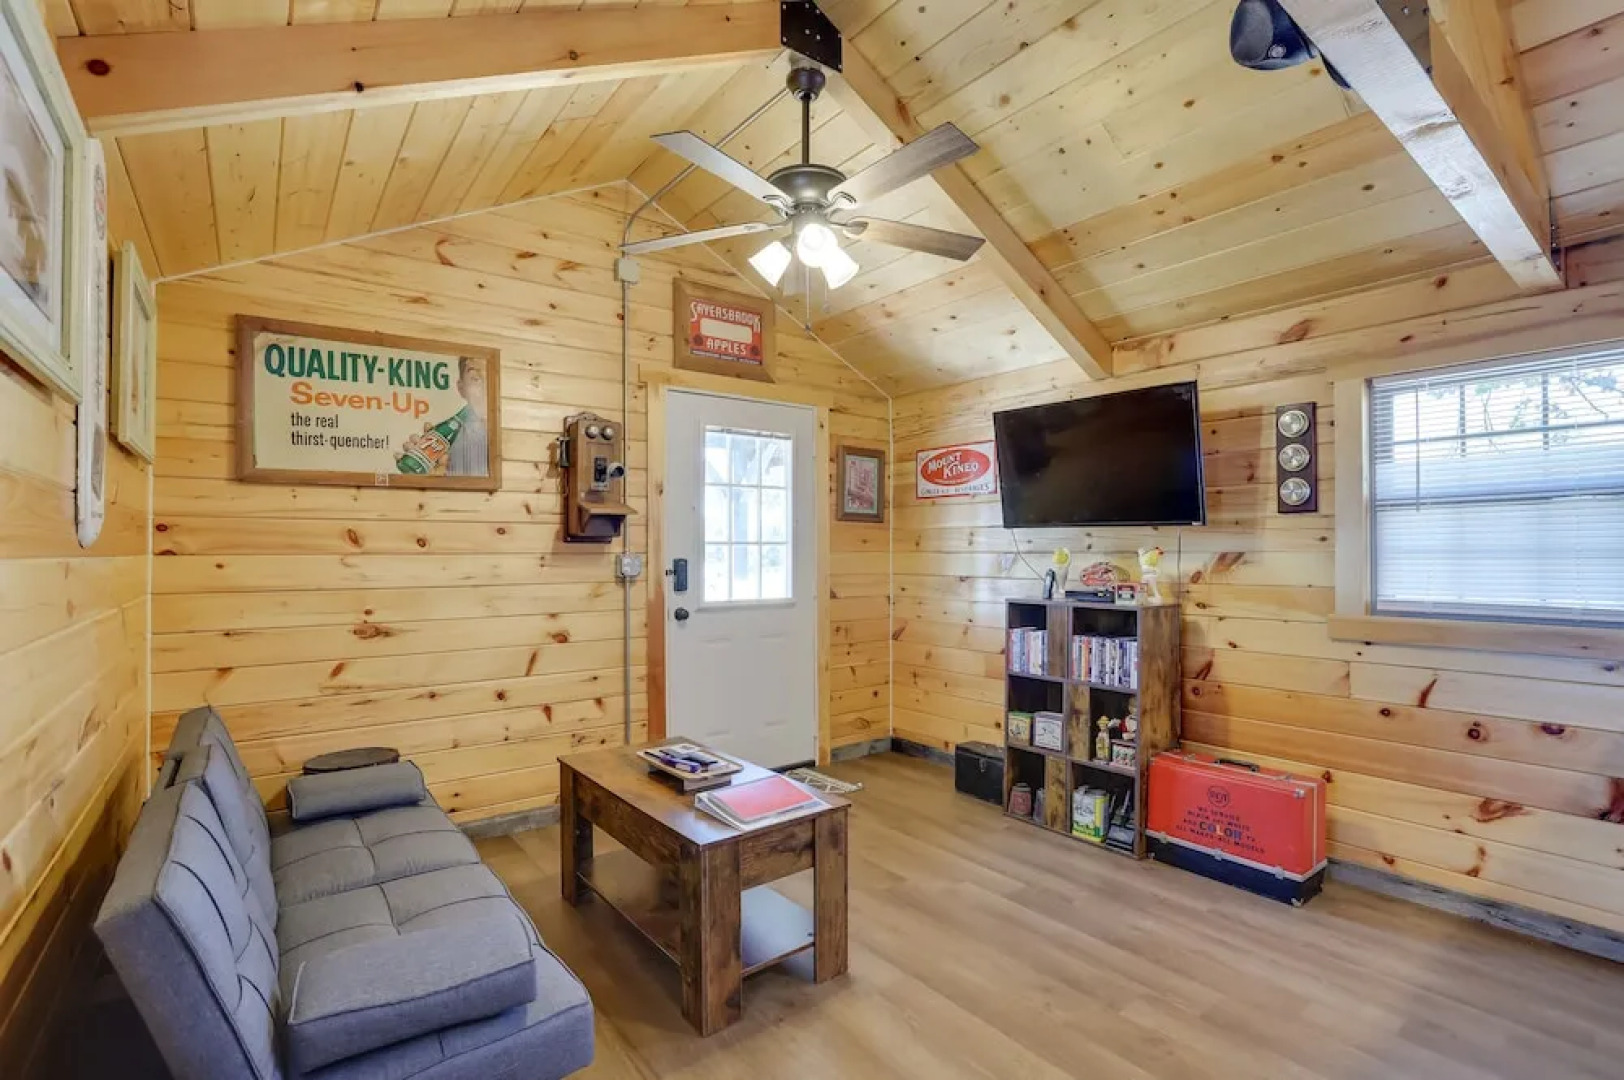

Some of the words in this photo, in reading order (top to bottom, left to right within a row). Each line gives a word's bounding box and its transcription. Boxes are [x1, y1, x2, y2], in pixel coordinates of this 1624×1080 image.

[707, 337, 747, 355] APPLES
[264, 343, 450, 390] QUALITY-KING
[290, 381, 430, 419] Seven-Up
[290, 412, 312, 428] the
[315, 414, 339, 428] real
[290, 431, 390, 450] thirst-quencher!
[928, 452, 962, 475] MOUNT
[943, 461, 978, 480] KINEO
[1200, 821, 1241, 841] COLOR
